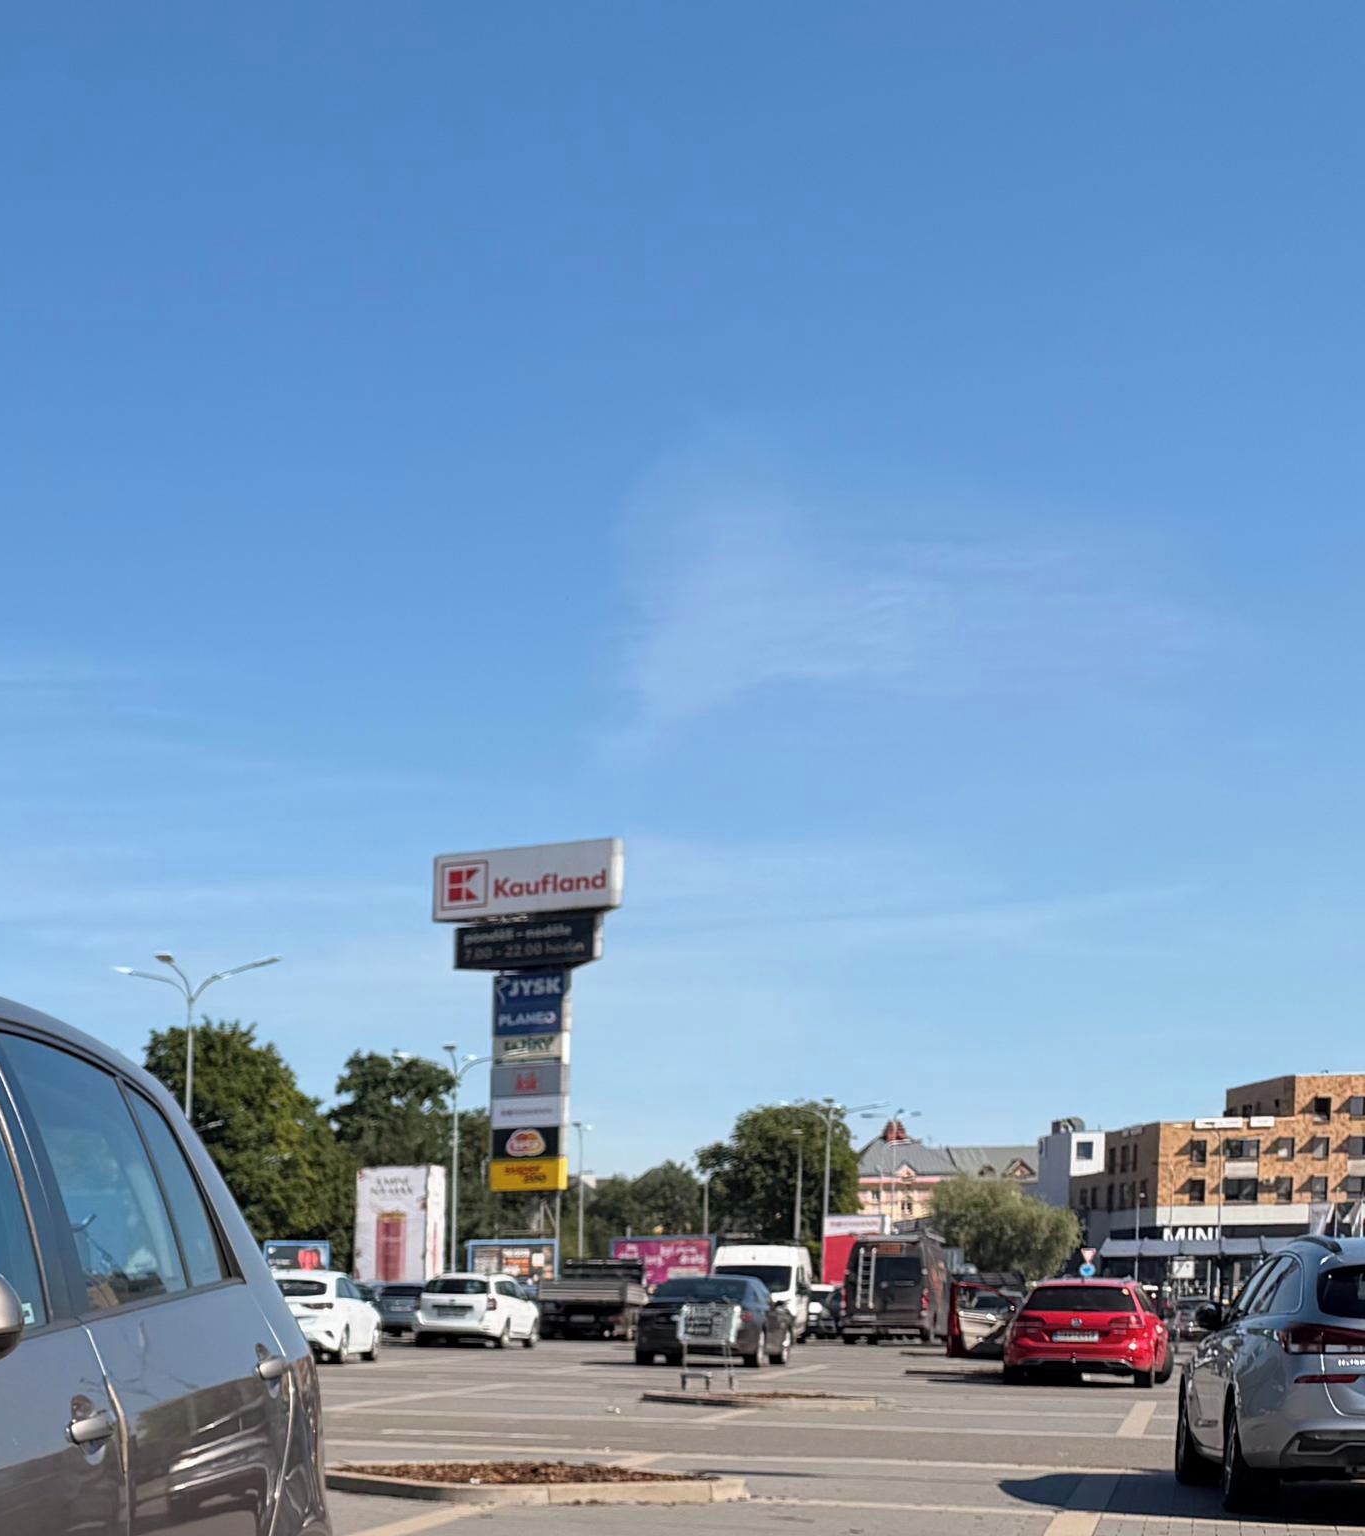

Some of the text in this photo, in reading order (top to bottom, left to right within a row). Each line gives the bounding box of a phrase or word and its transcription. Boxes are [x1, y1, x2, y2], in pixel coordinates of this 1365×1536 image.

[492, 869, 608, 899] Kaufland
[507, 976, 562, 997] JYSK
[497, 1012, 557, 1027] PLANEO
[1162, 1226, 1220, 1242] MINI
